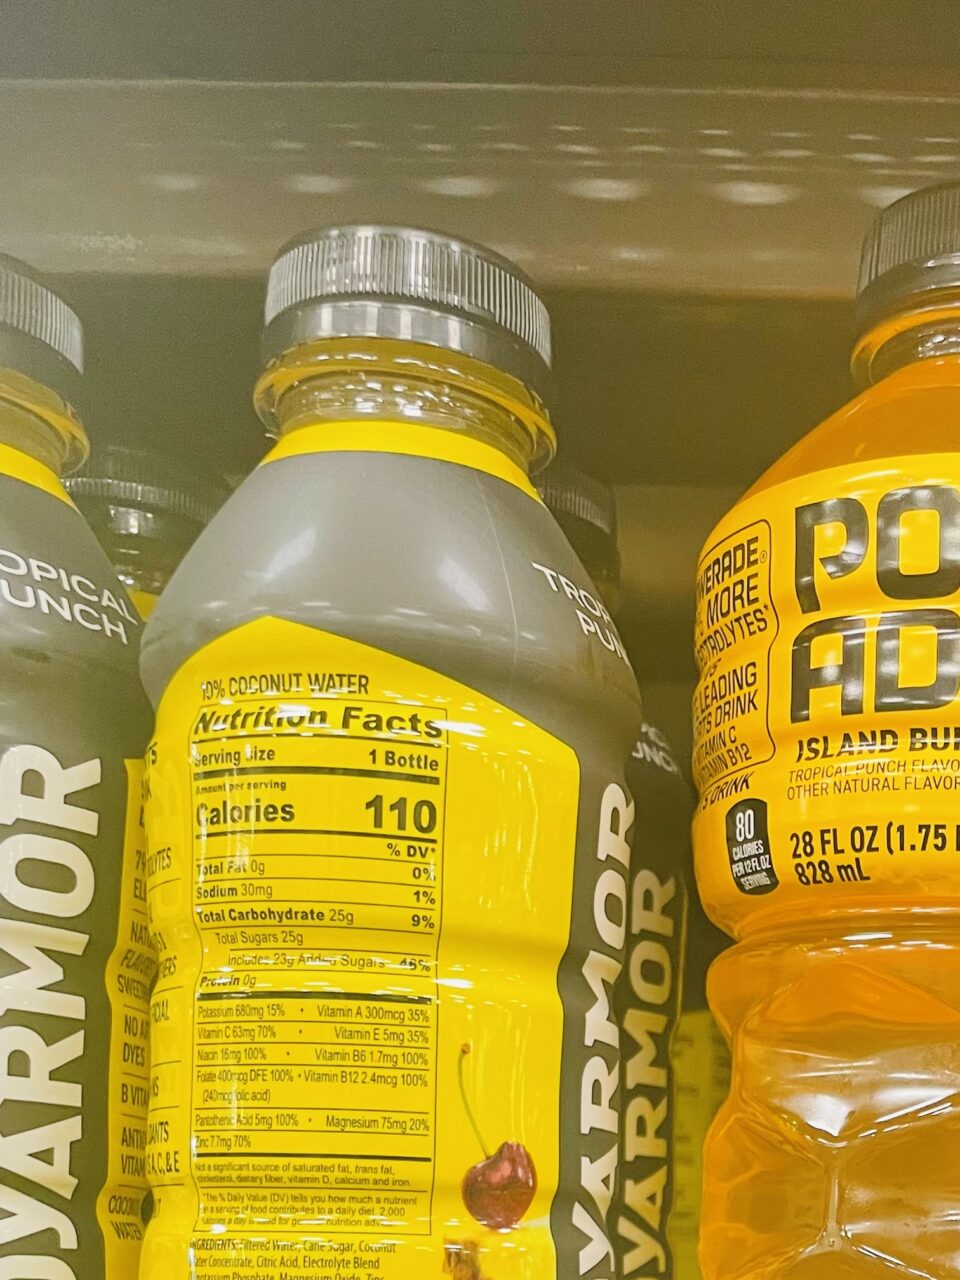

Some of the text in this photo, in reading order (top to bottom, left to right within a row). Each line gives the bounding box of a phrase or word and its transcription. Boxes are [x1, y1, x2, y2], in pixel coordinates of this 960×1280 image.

[706, 572, 760, 630] MORE
[229, 672, 370, 697] COCONUT WATER
[699, 661, 757, 714] LEADING
[714, 688, 758, 728] DRINK
[193, 705, 443, 739] Nutrition Facts
[726, 742, 752, 767] B12
[796, 729, 899, 763] ISLAND
[369, 749, 440, 771] 1 Bottle
[788, 764, 850, 784] TROPICAL
[855, 760, 906, 776] PUNCH
[710, 773, 753, 805] DRINK
[787, 778, 829, 801] OTHER
[832, 776, 900, 794] NATURAL
[196, 794, 438, 834] Calories 110
[735, 809, 755, 842] 80
[732, 839, 764, 861] CALORIES
[789, 829, 815, 860] 28
[820, 827, 846, 856] FL
[850, 825, 880, 853] OZ
[886, 821, 948, 856] (1.75
[732, 861, 745, 878] PER
[751, 857, 762, 873] FL
[760, 854, 772, 871] OZ
[794, 857, 871, 887] 828 mL
[196, 883, 273, 900] Sodium 30mg
[413, 890, 436, 905] 1%
[197, 906, 354, 926] Total Carbohydrate 25g
[411, 914, 435, 930] 9%
[326, 1114, 430, 1134] Magnesium 75mg 20%
[302, 1254, 380, 1271] Electrolyte Blend
